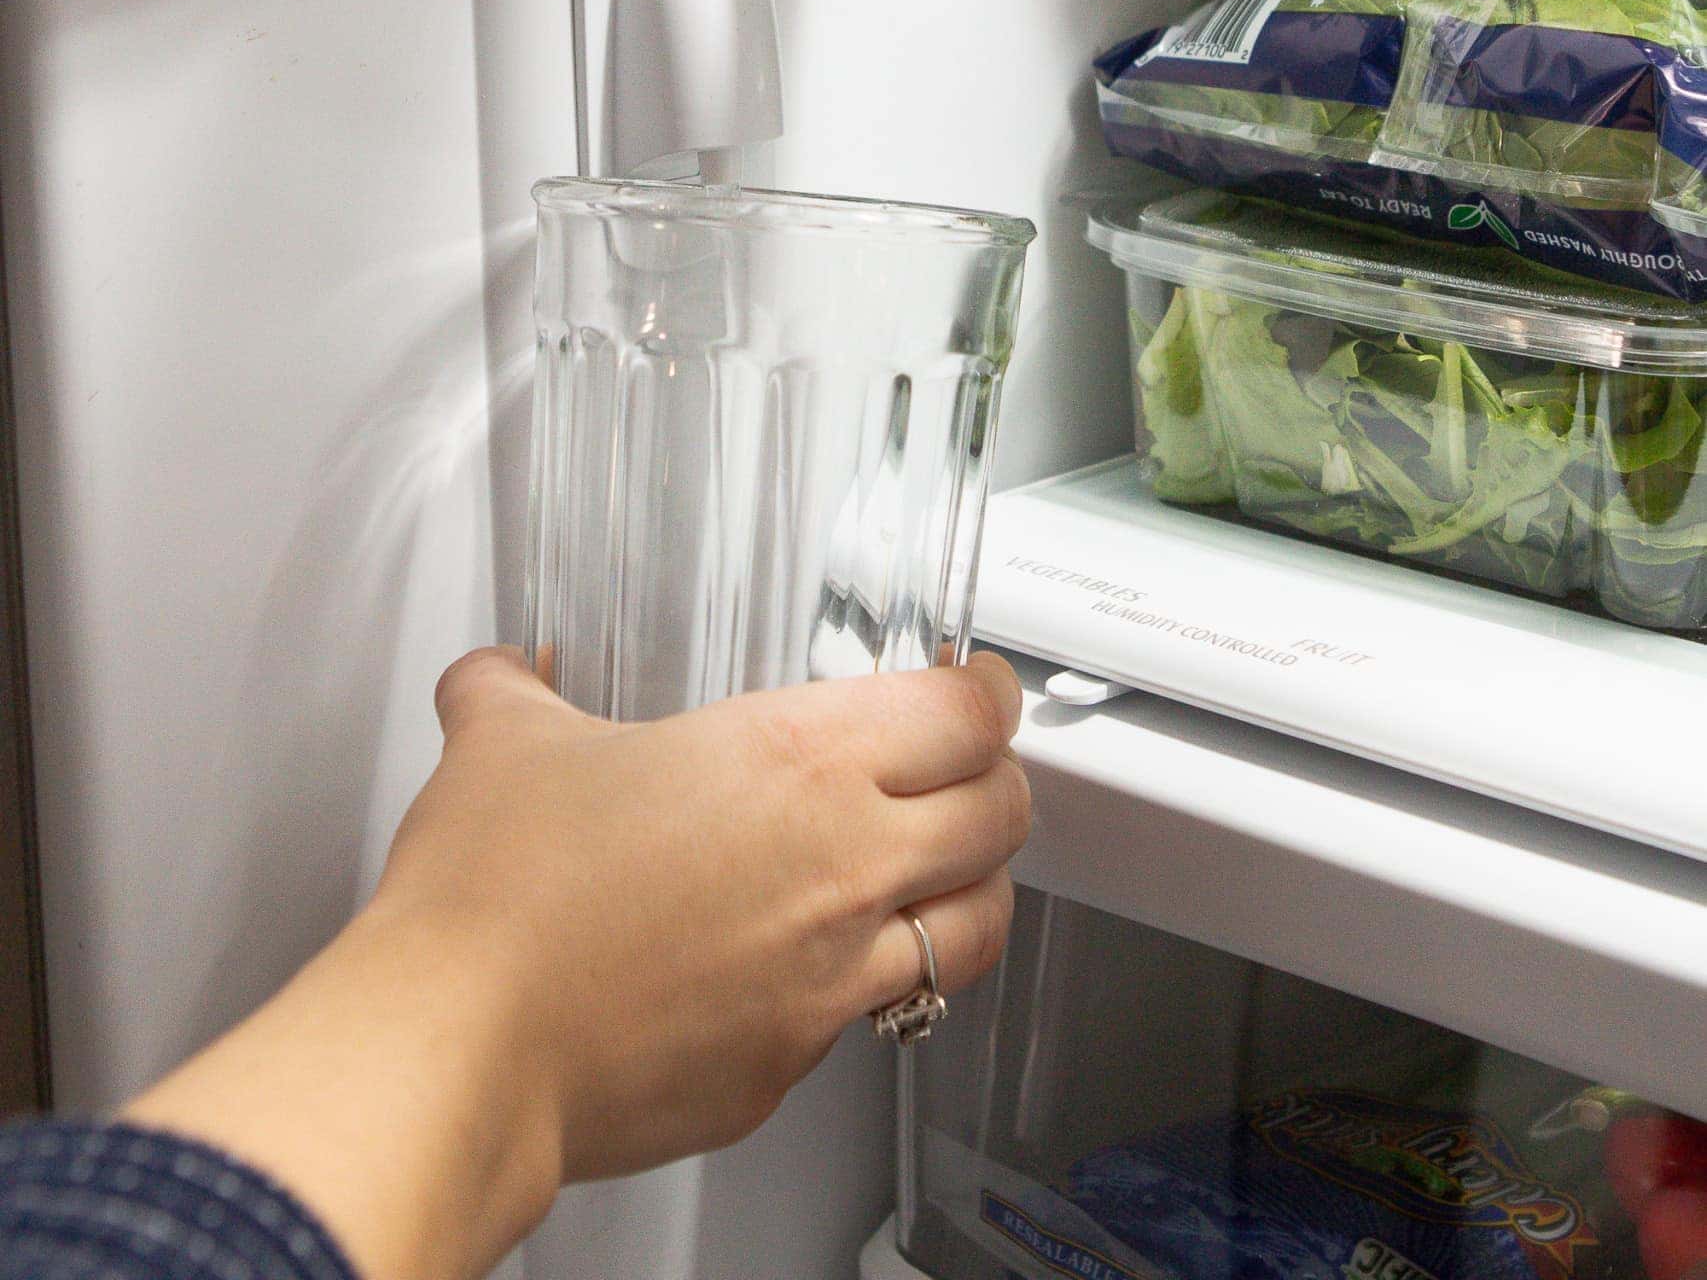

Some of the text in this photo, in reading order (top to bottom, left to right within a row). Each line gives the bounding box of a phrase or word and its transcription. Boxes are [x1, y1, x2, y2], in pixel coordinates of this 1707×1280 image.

[1351, 194, 1375, 211] TO
[1379, 198, 1432, 220] READY
[1525, 229, 1596, 258] WASHED
[1004, 555, 1149, 603] VEGETABLES
[1090, 599, 1300, 667] HUMIDITY CONTROLLED
[1289, 638, 1378, 666] FRUIT
